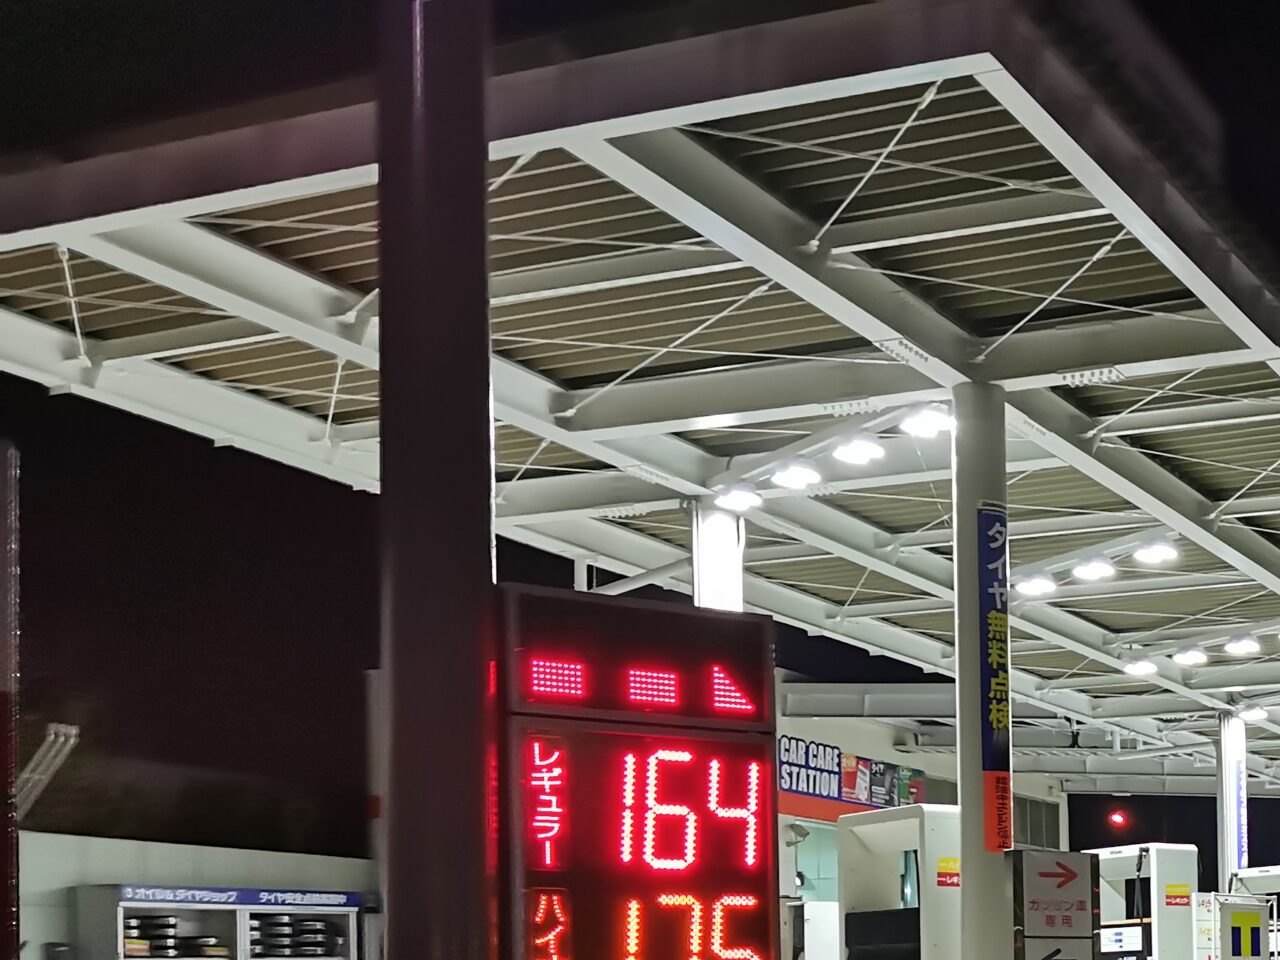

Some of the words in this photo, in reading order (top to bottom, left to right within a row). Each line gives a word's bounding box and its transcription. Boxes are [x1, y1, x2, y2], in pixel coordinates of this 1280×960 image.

[779, 735, 806, 765] CAR
[808, 740, 840, 773] CARE
[780, 764, 840, 799] STATION
[530, 742, 563, 866] レギュラー
[620, 749, 760, 871] 164
